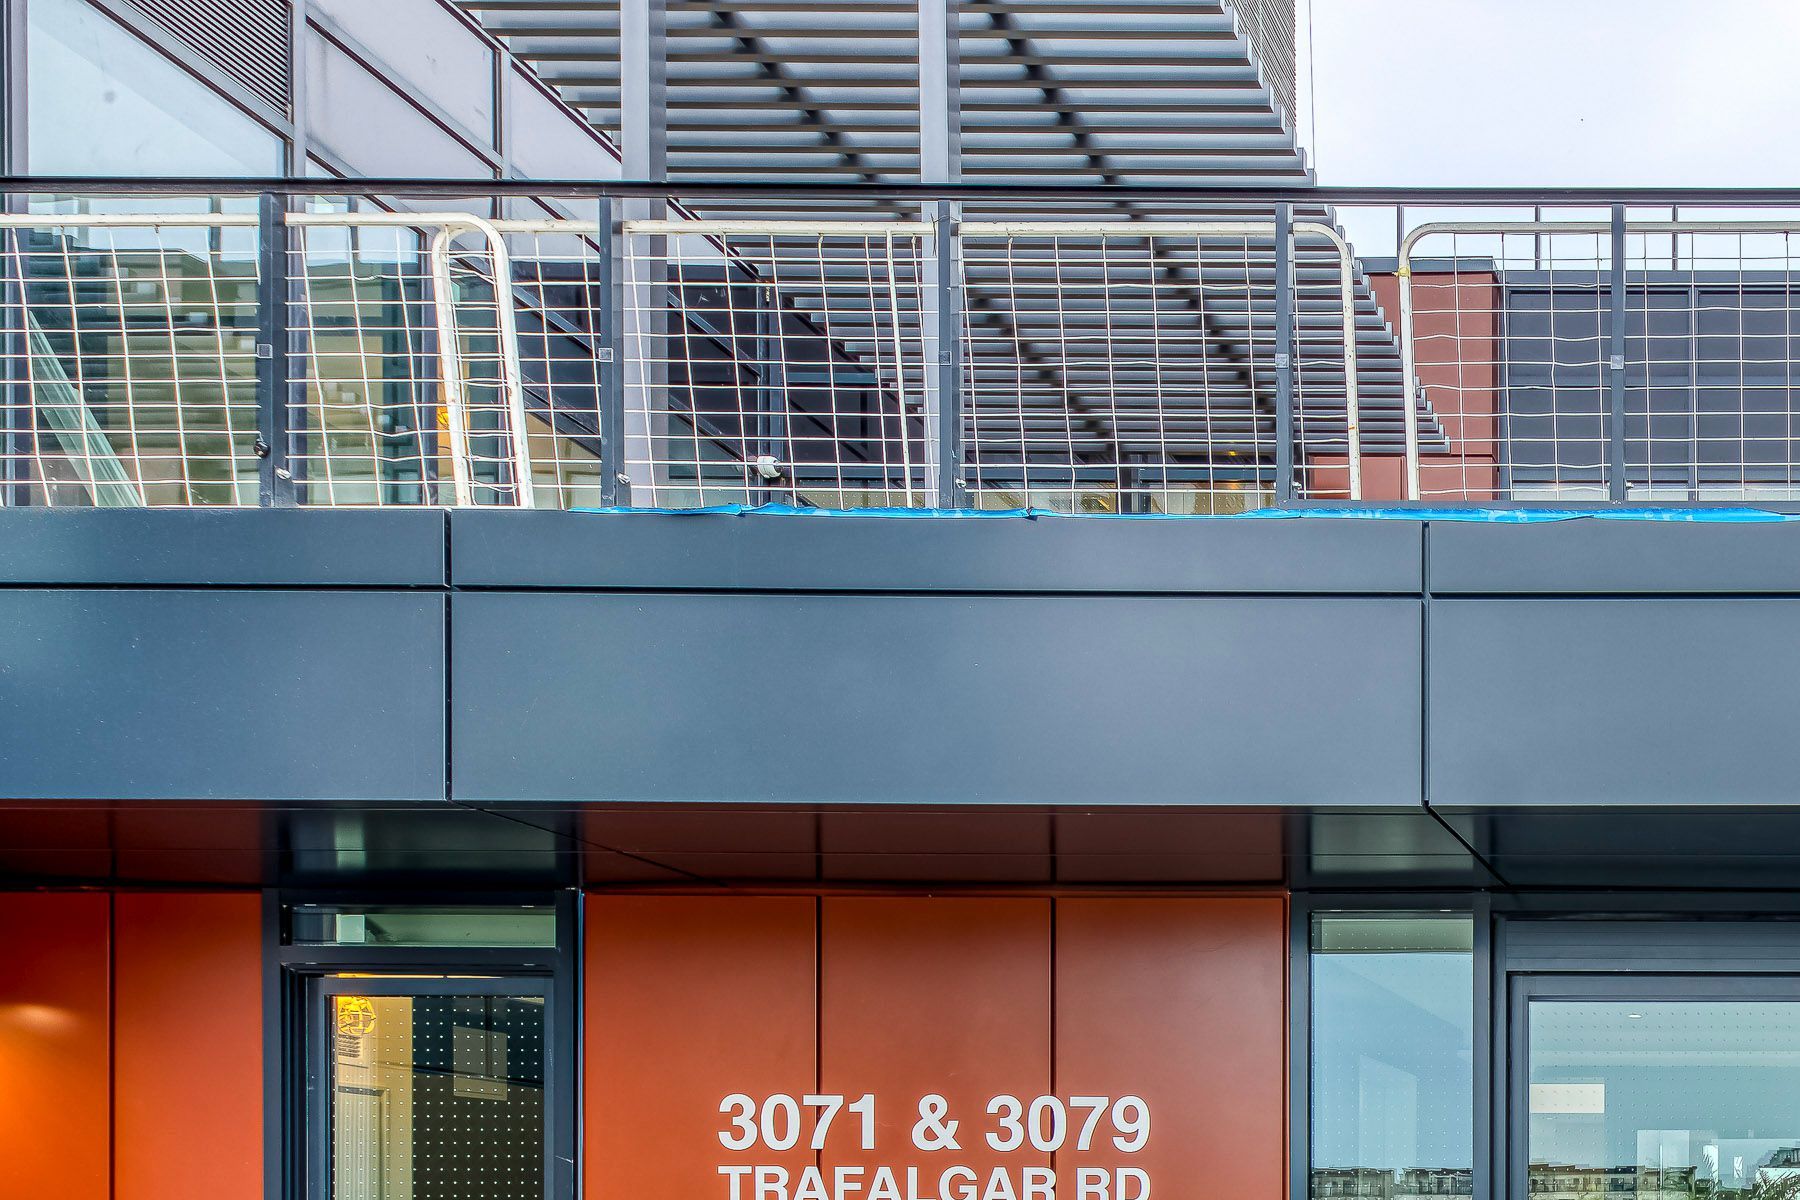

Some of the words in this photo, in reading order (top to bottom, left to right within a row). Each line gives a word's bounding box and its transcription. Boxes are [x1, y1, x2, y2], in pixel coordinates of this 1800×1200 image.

[718, 1093, 875, 1151] 3071
[911, 1093, 962, 1152] &
[985, 1094, 1151, 1153] 3079
